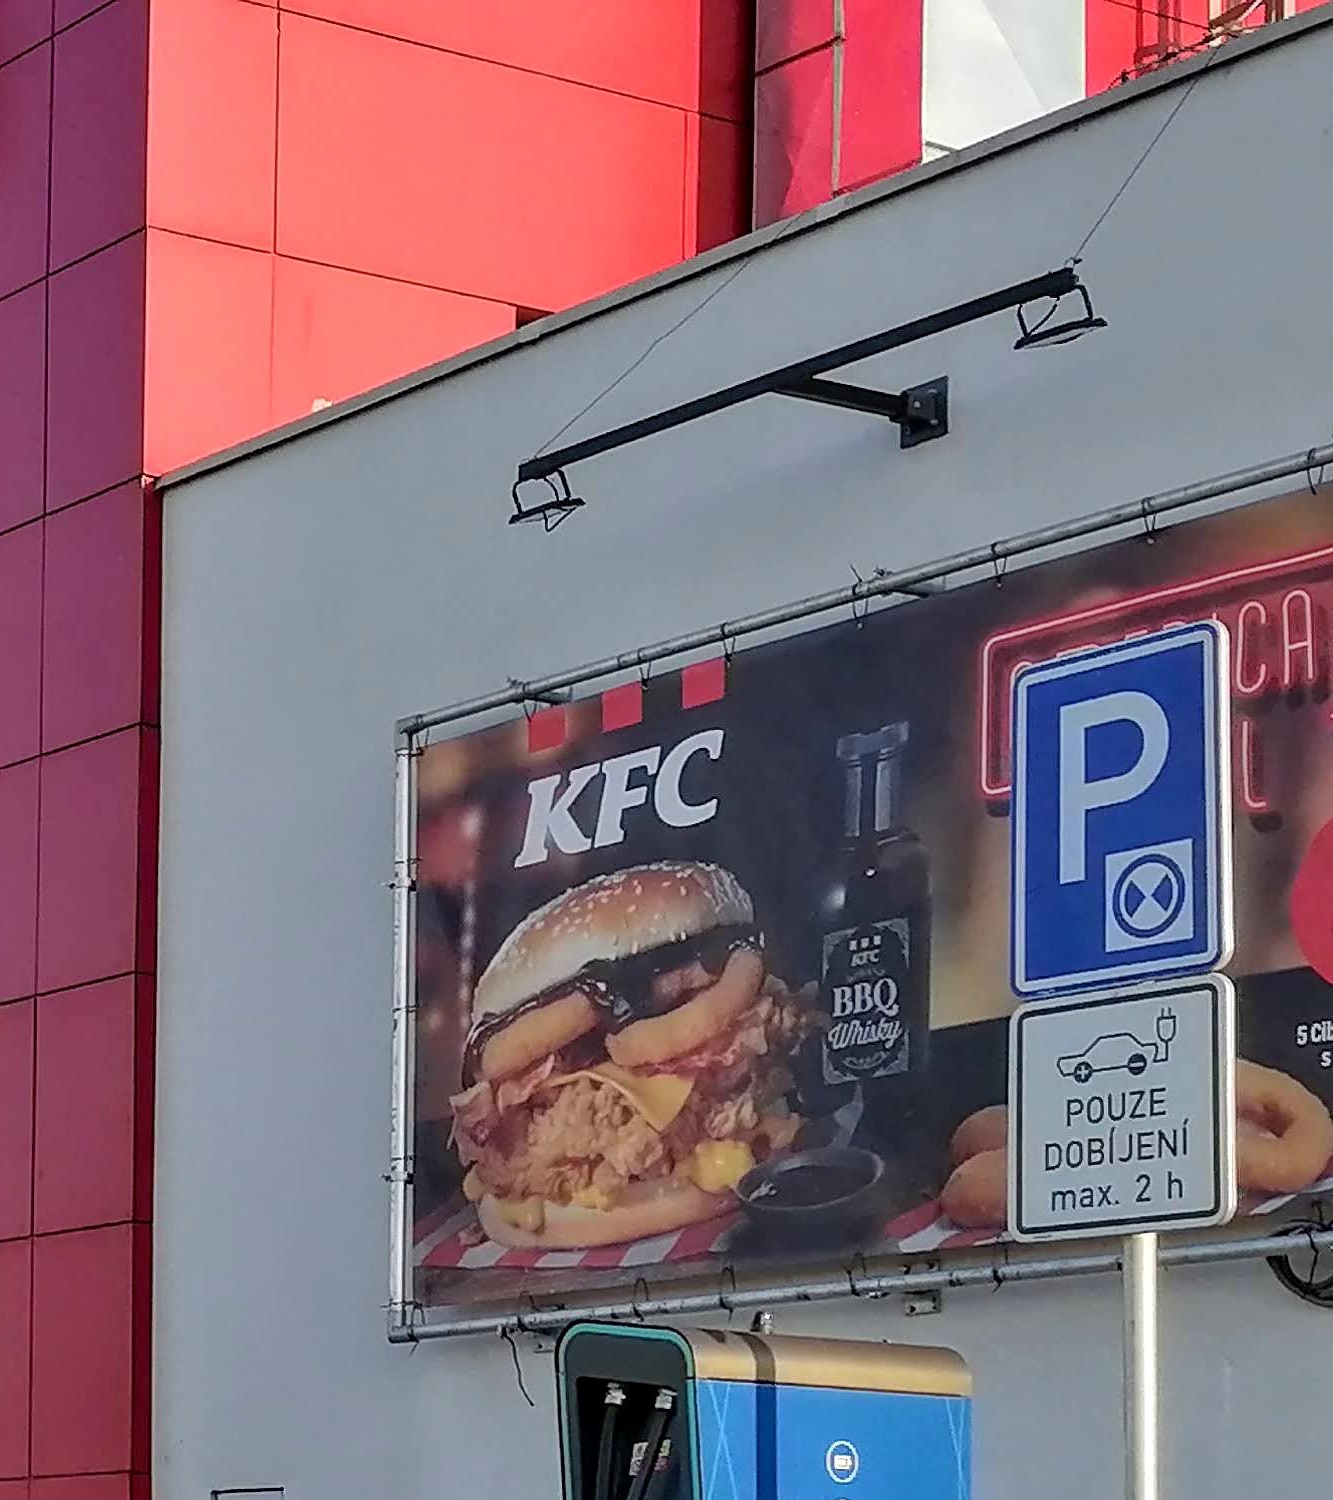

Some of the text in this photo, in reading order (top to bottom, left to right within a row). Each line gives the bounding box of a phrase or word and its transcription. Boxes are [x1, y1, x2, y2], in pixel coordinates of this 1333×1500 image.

[514, 729, 724, 868] KFC
[1060, 691, 1169, 886] P
[833, 977, 900, 1017] BBQ
[828, 1018, 903, 1049] Whisky
[1066, 1087, 1166, 1126] POUZE
[1045, 1118, 1189, 1171] DOBÍJENÍ
[1051, 1171, 1183, 1212] max. 2 h
